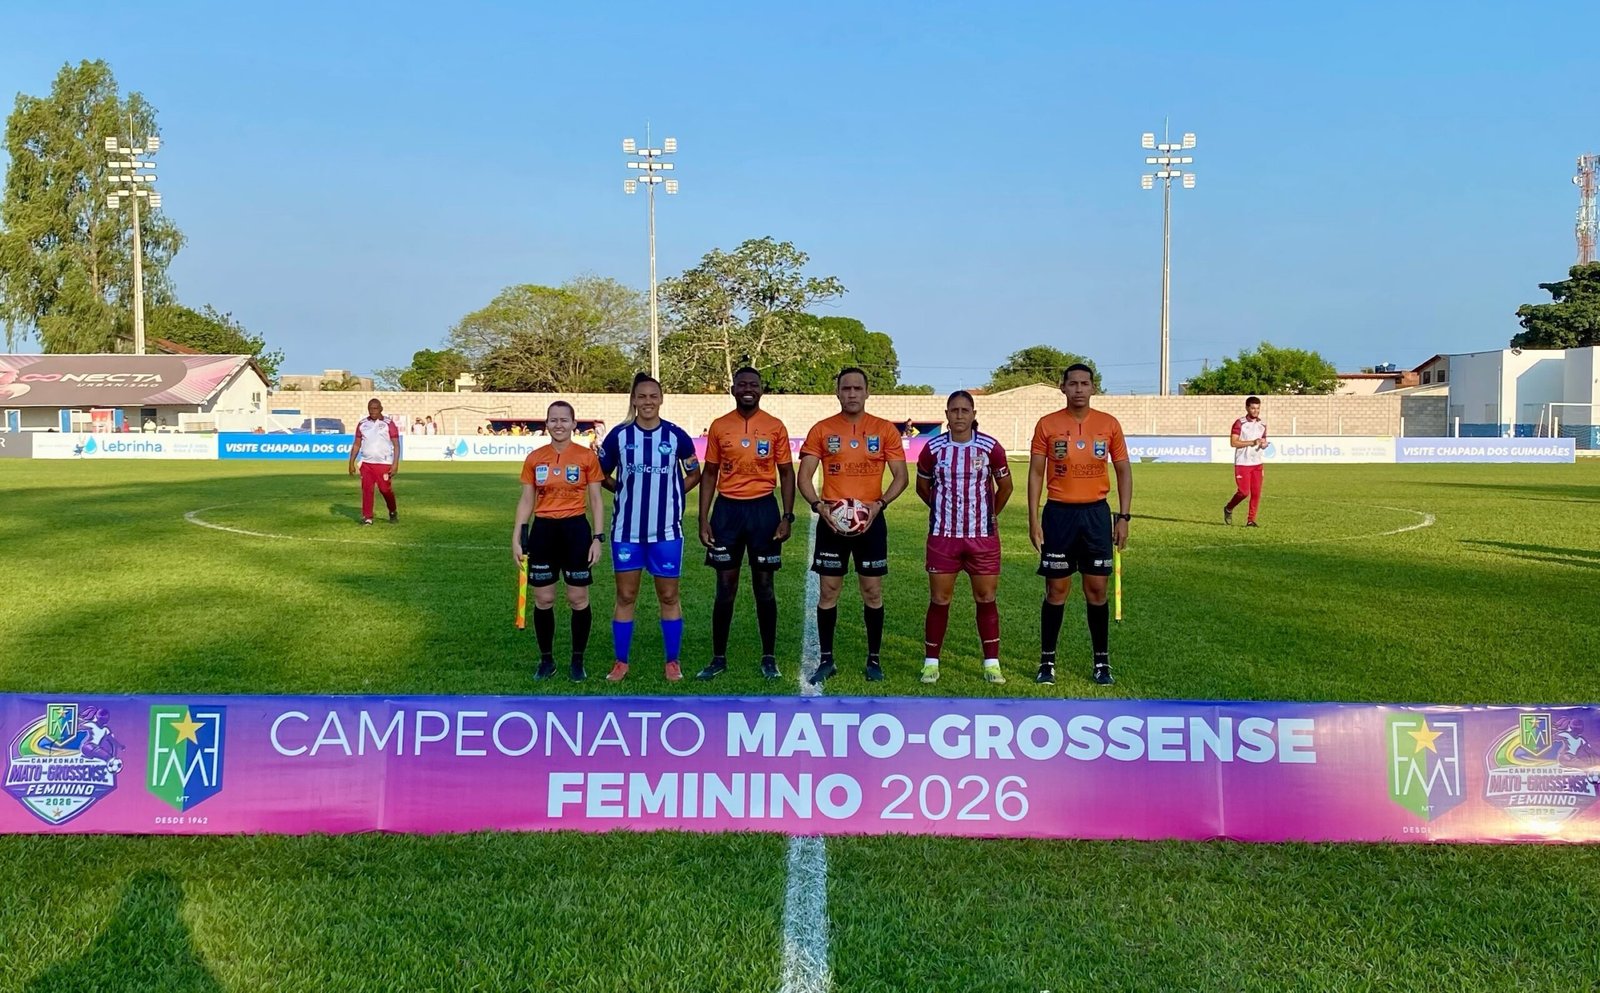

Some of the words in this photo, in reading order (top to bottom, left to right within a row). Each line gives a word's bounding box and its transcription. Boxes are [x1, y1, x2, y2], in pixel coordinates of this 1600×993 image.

[102, 440, 162, 453] Lebrinha
[226, 443, 258, 453] VISITE
[260, 443, 309, 453] CHAPADA
[312, 443, 334, 453] DOS
[473, 442, 534, 455] Lebrinha
[1130, 446, 1144, 456] OS
[1146, 444, 1207, 456] GUIMARÃES
[1280, 443, 1341, 457] Lebrinha
[1403, 447, 1435, 456] VISITE
[1437, 447, 1485, 456] CHAPADA
[1487, 447, 1509, 456] DOS
[1511, 445, 1570, 456] GUIMARÃES
[637, 464, 669, 473] Sicredi
[271, 711, 705, 757] CAMPEONATO
[727, 712, 1317, 764] MATO-GROSSENSE
[9, 764, 108, 783] MATO-GROSSENSE
[27, 784, 95, 795] FEMININO
[1489, 774, 1591, 794] MATO-GROSSENSE
[46, 798, 71, 806] 2026
[548, 772, 863, 820] FEMININO
[880, 774, 1030, 822] 2026
[1509, 795, 1577, 806] FEMININO
